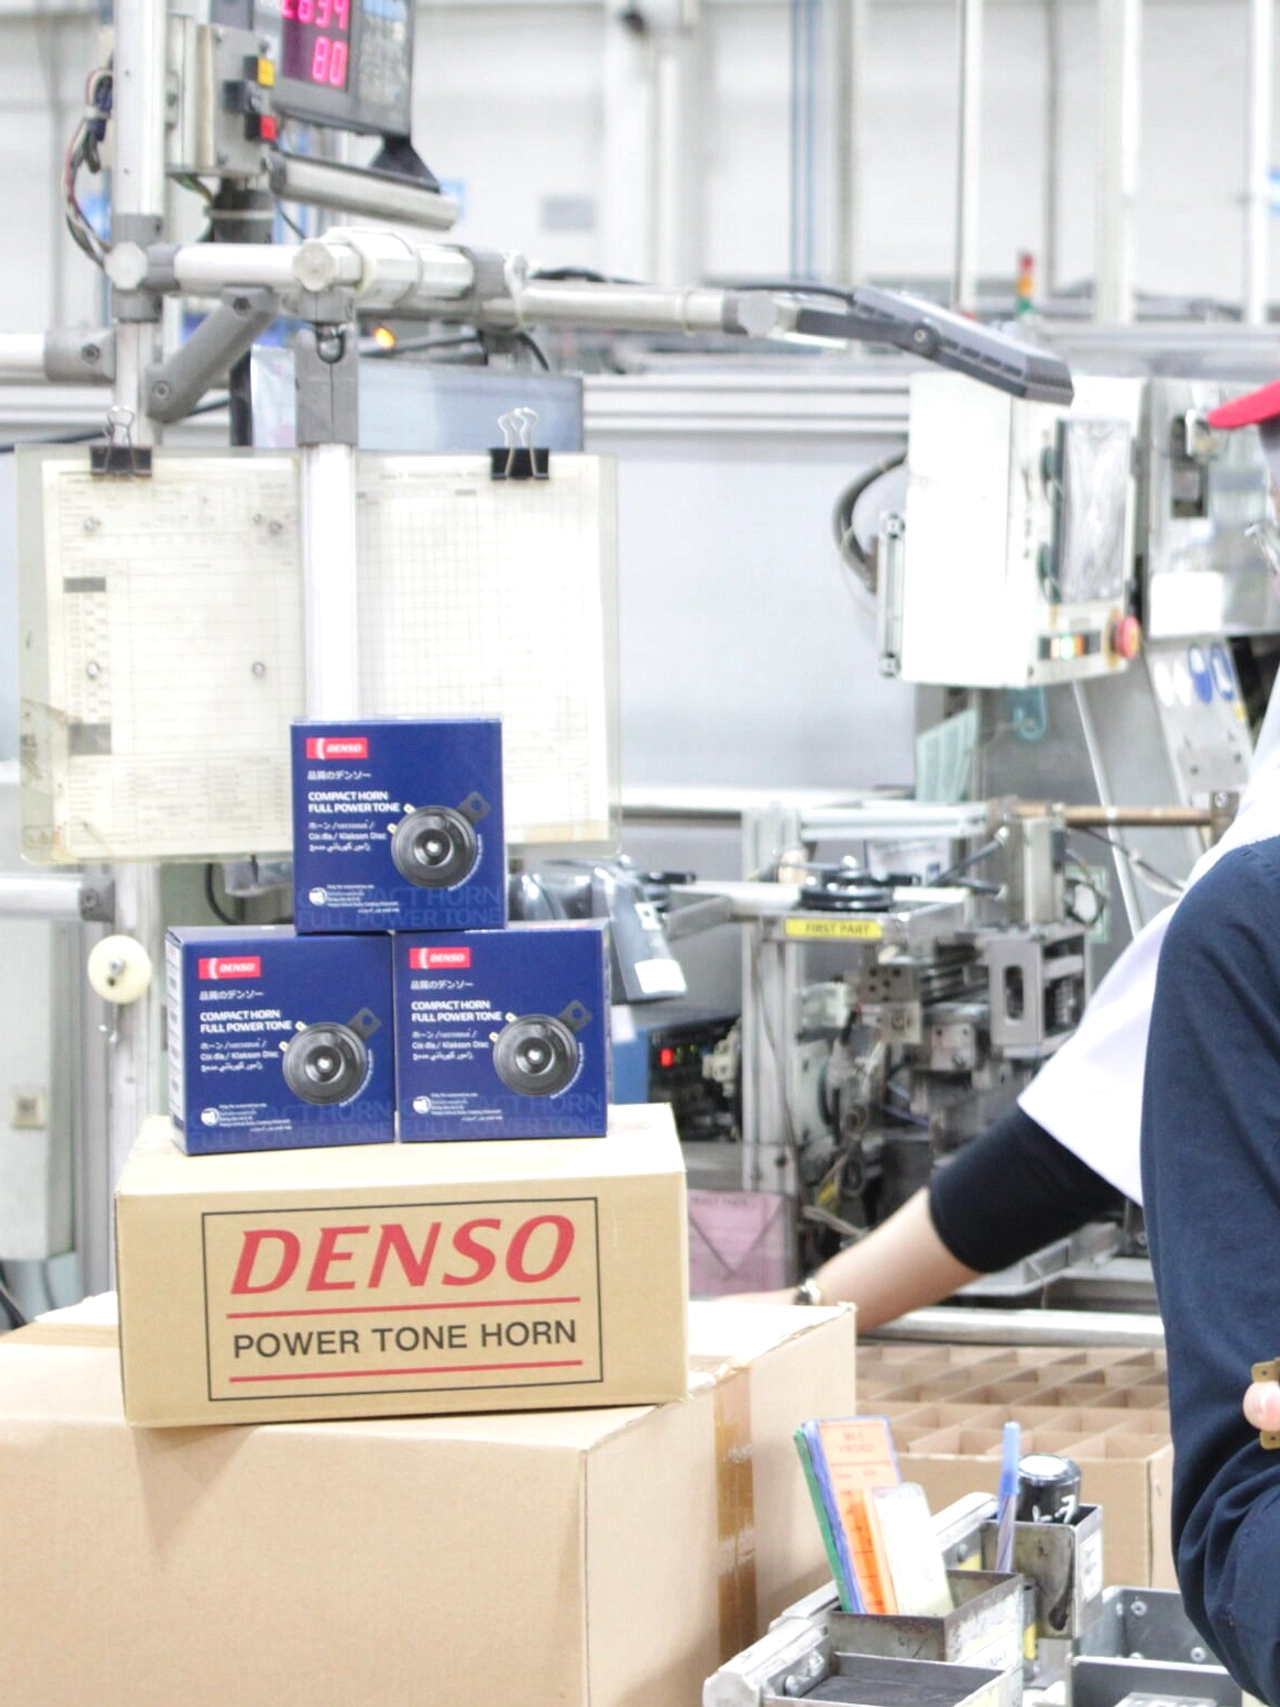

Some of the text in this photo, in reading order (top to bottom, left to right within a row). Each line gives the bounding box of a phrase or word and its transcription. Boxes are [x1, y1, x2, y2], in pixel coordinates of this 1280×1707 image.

[312, 35, 348, 87] 80
[326, 744, 362, 753] DENSO
[308, 791, 388, 801] COMPACT HORN
[308, 803, 399, 813] FULL POWER TONE
[806, 923, 869, 934] FIRST PART
[430, 954, 464, 963] DENSO
[219, 963, 254, 973] DENSO
[412, 1001, 490, 1010] COMPACT HORN
[200, 1009, 280, 1021] COMPACT HORN
[412, 1011, 501, 1022] FULL POWER TONE
[200, 1020, 291, 1033] FULL POWER TONE
[230, 1214, 575, 1295] DENSO
[233, 1319, 576, 1359] POWER TONE HORN
